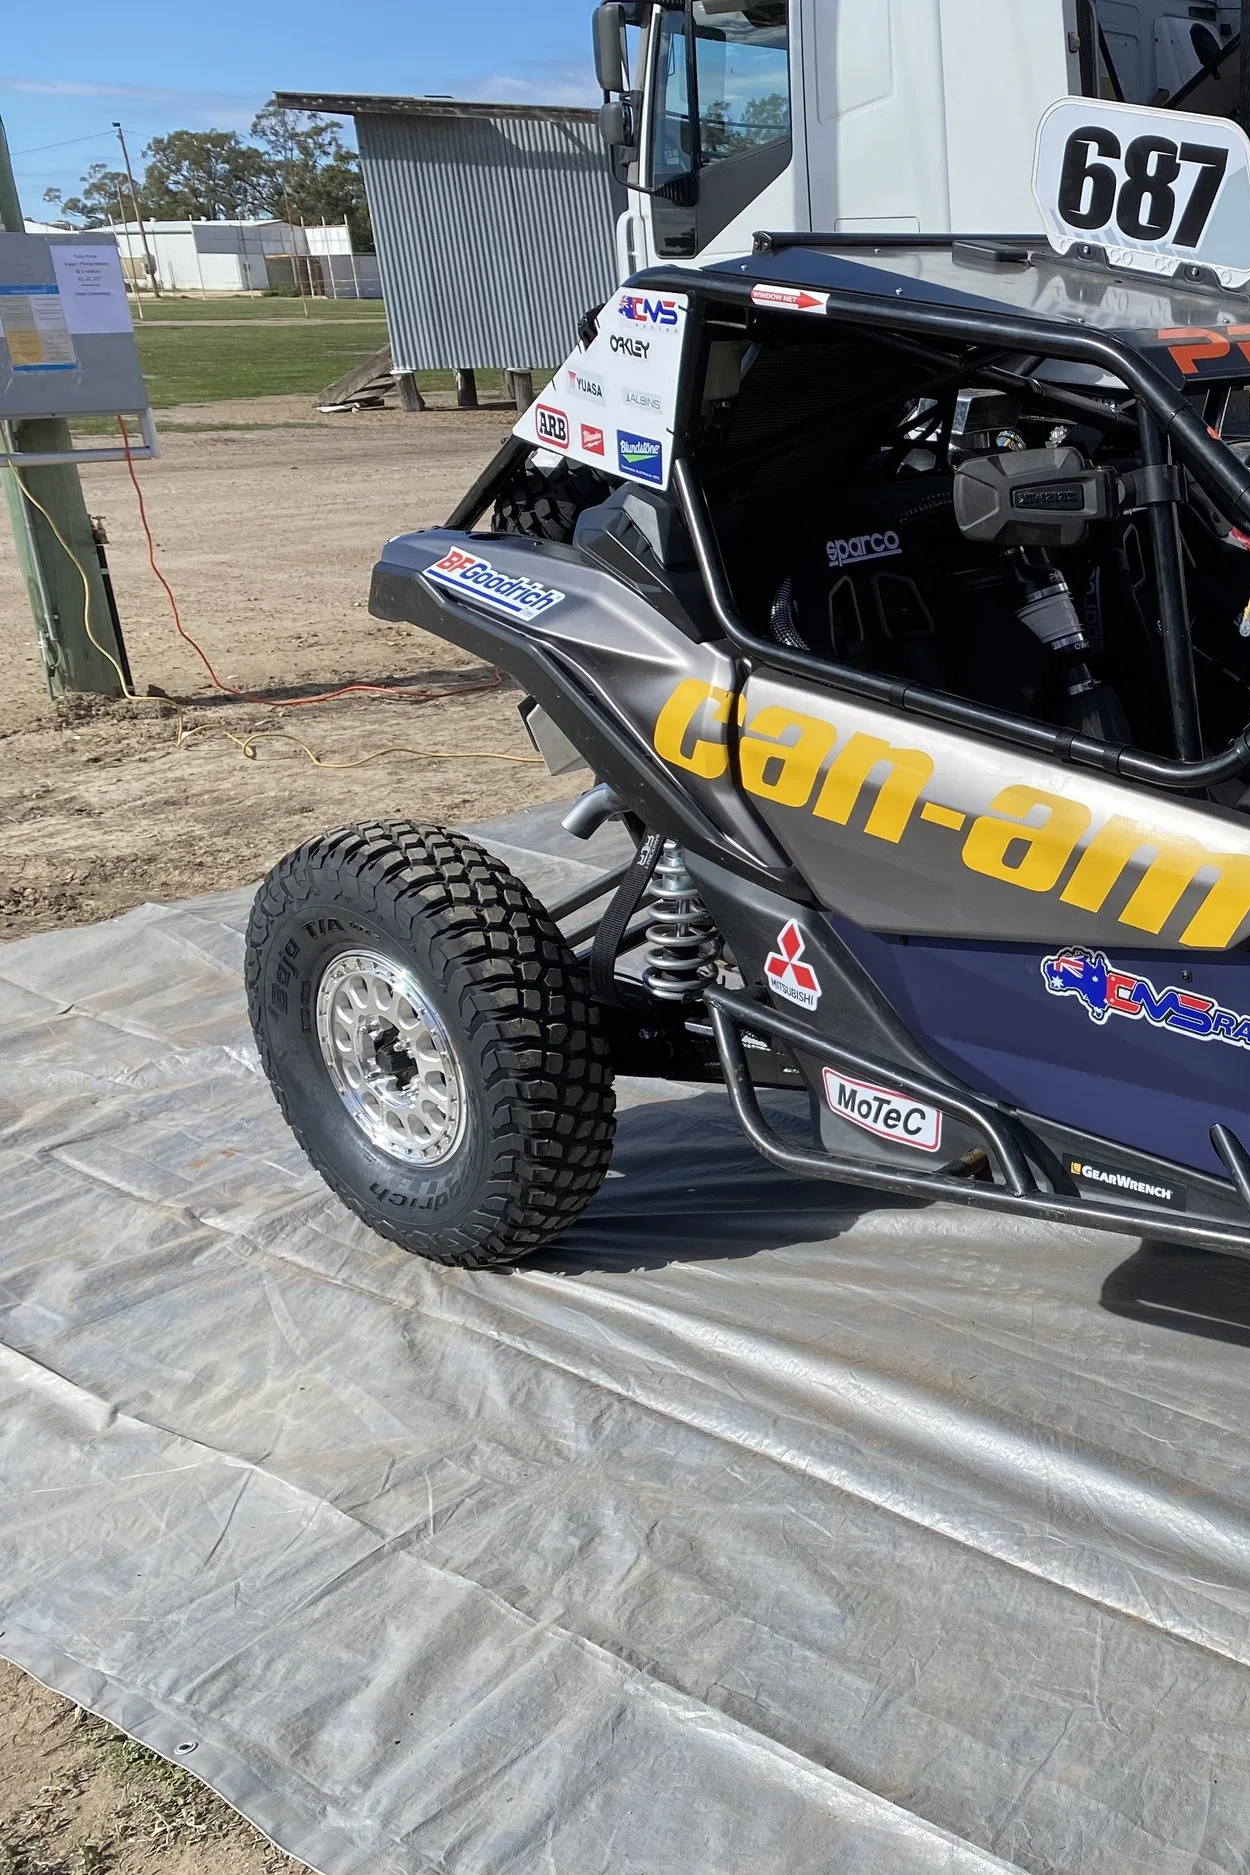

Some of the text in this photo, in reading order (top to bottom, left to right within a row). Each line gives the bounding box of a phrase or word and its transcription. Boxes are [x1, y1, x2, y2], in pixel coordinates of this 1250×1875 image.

[1058, 125, 1229, 248] 687
[752, 290, 782, 301] WINDOW
[610, 334, 650, 359] OAKLEY
[576, 377, 603, 398] YUASA
[540, 411, 566, 441] ARB
[826, 530, 901, 567] sparco
[436, 550, 557, 611] BFGoodrich
[771, 978, 814, 1006] MITSUBISHI
[1106, 971, 1213, 1034] CMS
[837, 1082, 927, 1136] MoTeC
